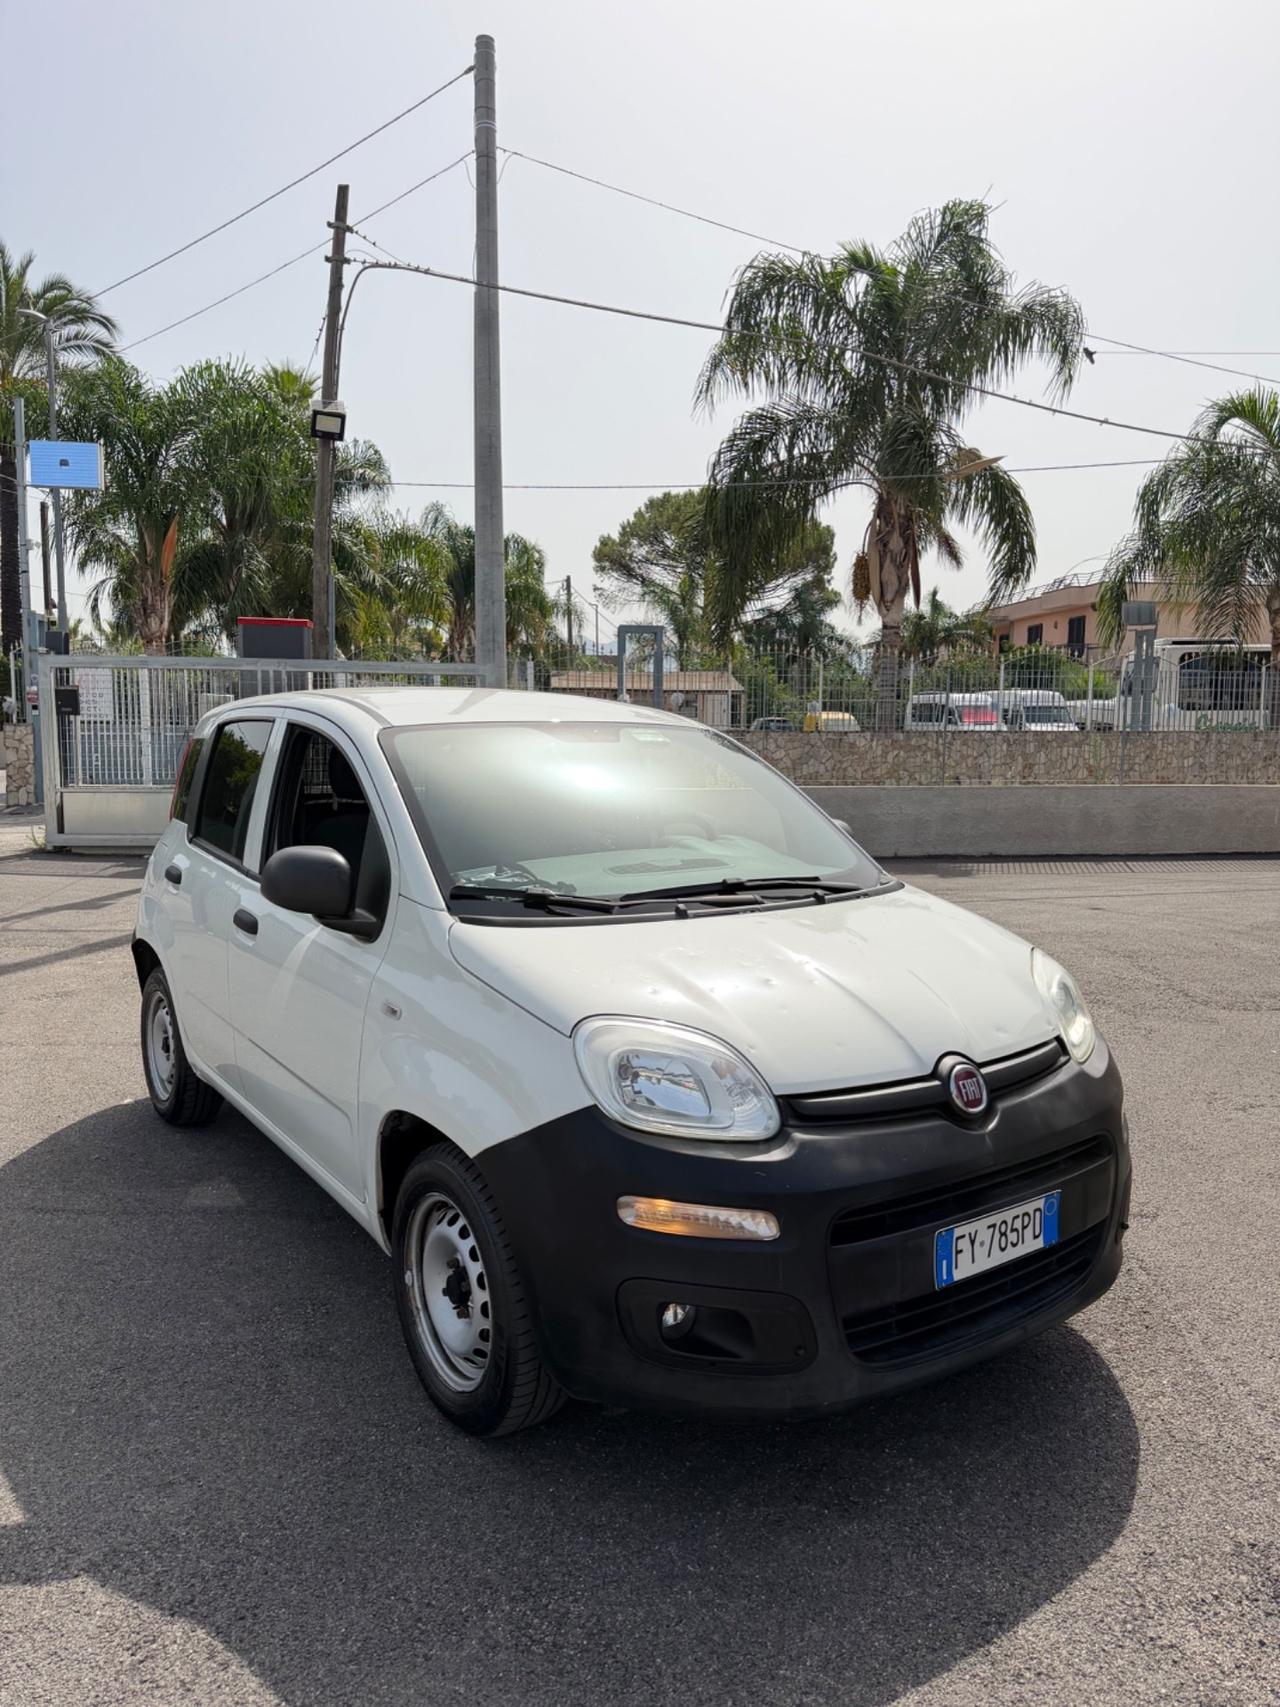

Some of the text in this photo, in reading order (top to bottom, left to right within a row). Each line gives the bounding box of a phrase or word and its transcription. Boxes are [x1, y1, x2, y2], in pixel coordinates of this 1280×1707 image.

[959, 1077, 981, 1102] FIAT
[954, 1207, 1043, 1270] FY 785PD
